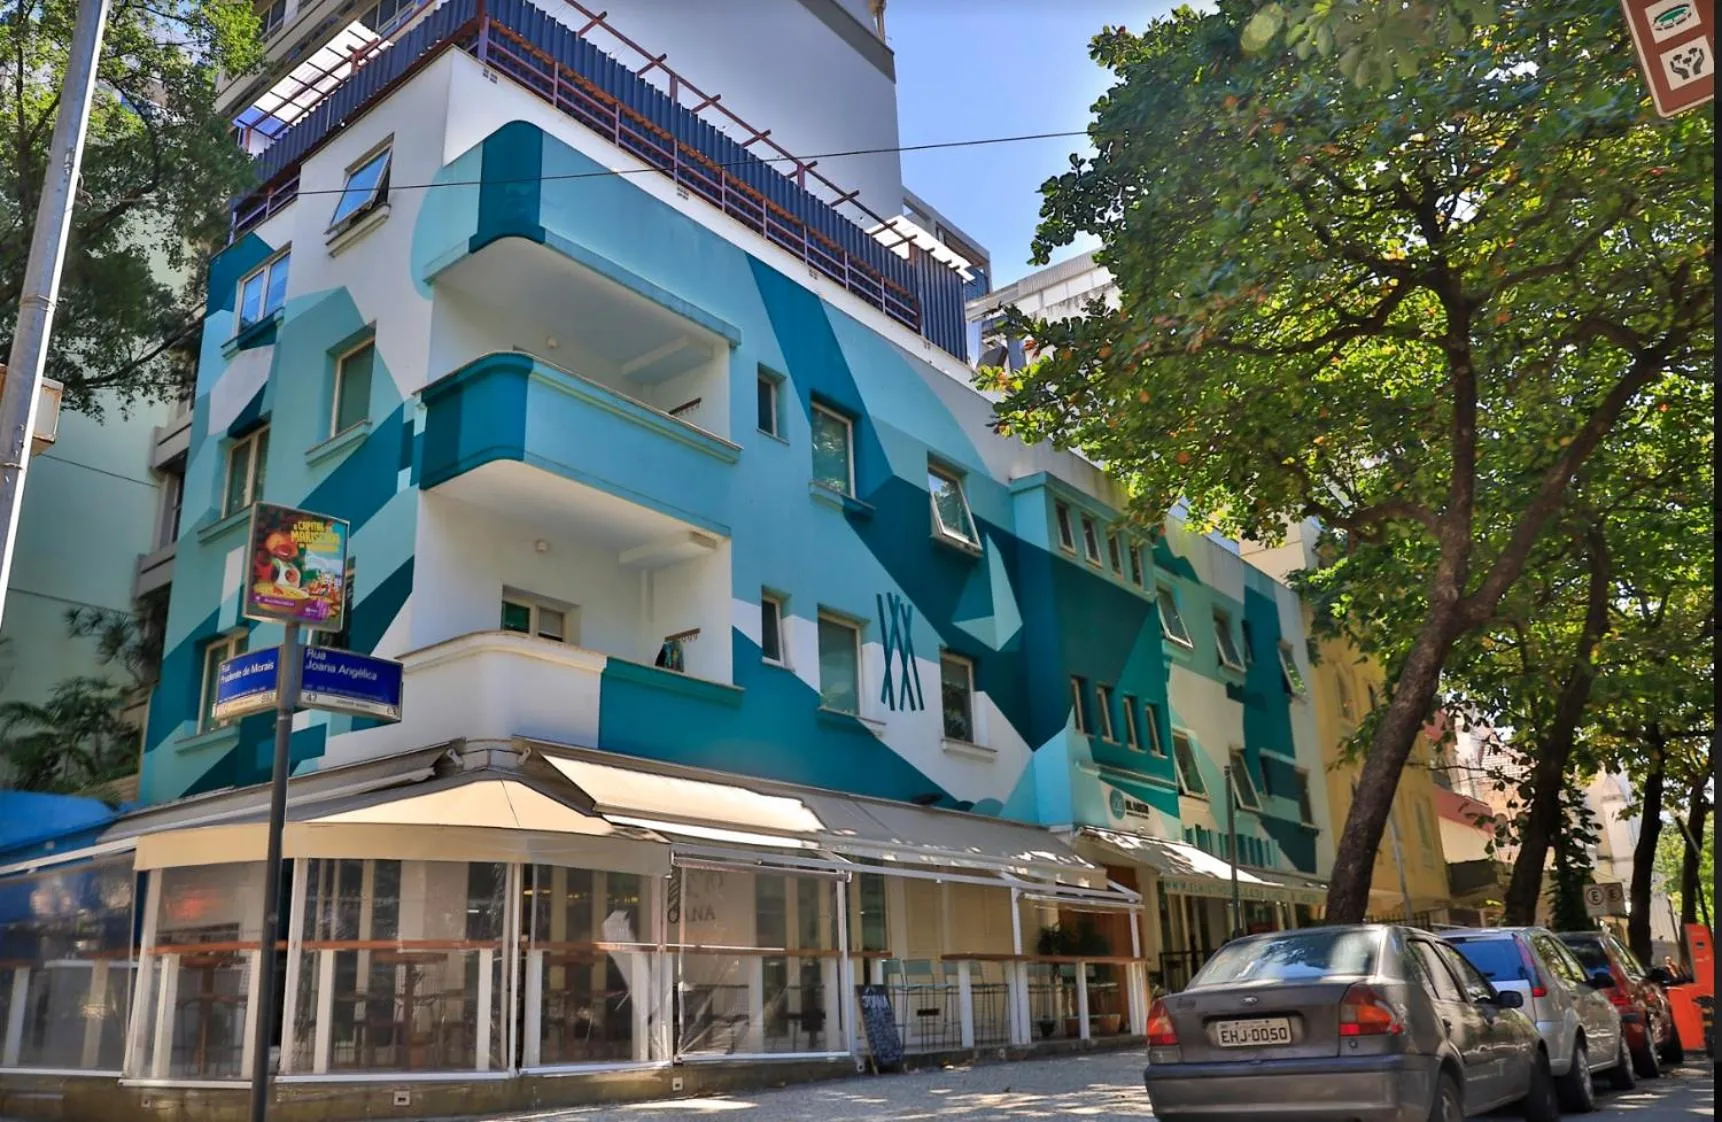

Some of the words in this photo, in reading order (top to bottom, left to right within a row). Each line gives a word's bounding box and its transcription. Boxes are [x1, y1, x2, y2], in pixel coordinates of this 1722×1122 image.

[306, 648, 327, 660] Rua
[242, 665, 250, 677] de
[250, 661, 274, 673] Morais
[305, 659, 336, 673] Joana
[338, 664, 378, 681] Angélica
